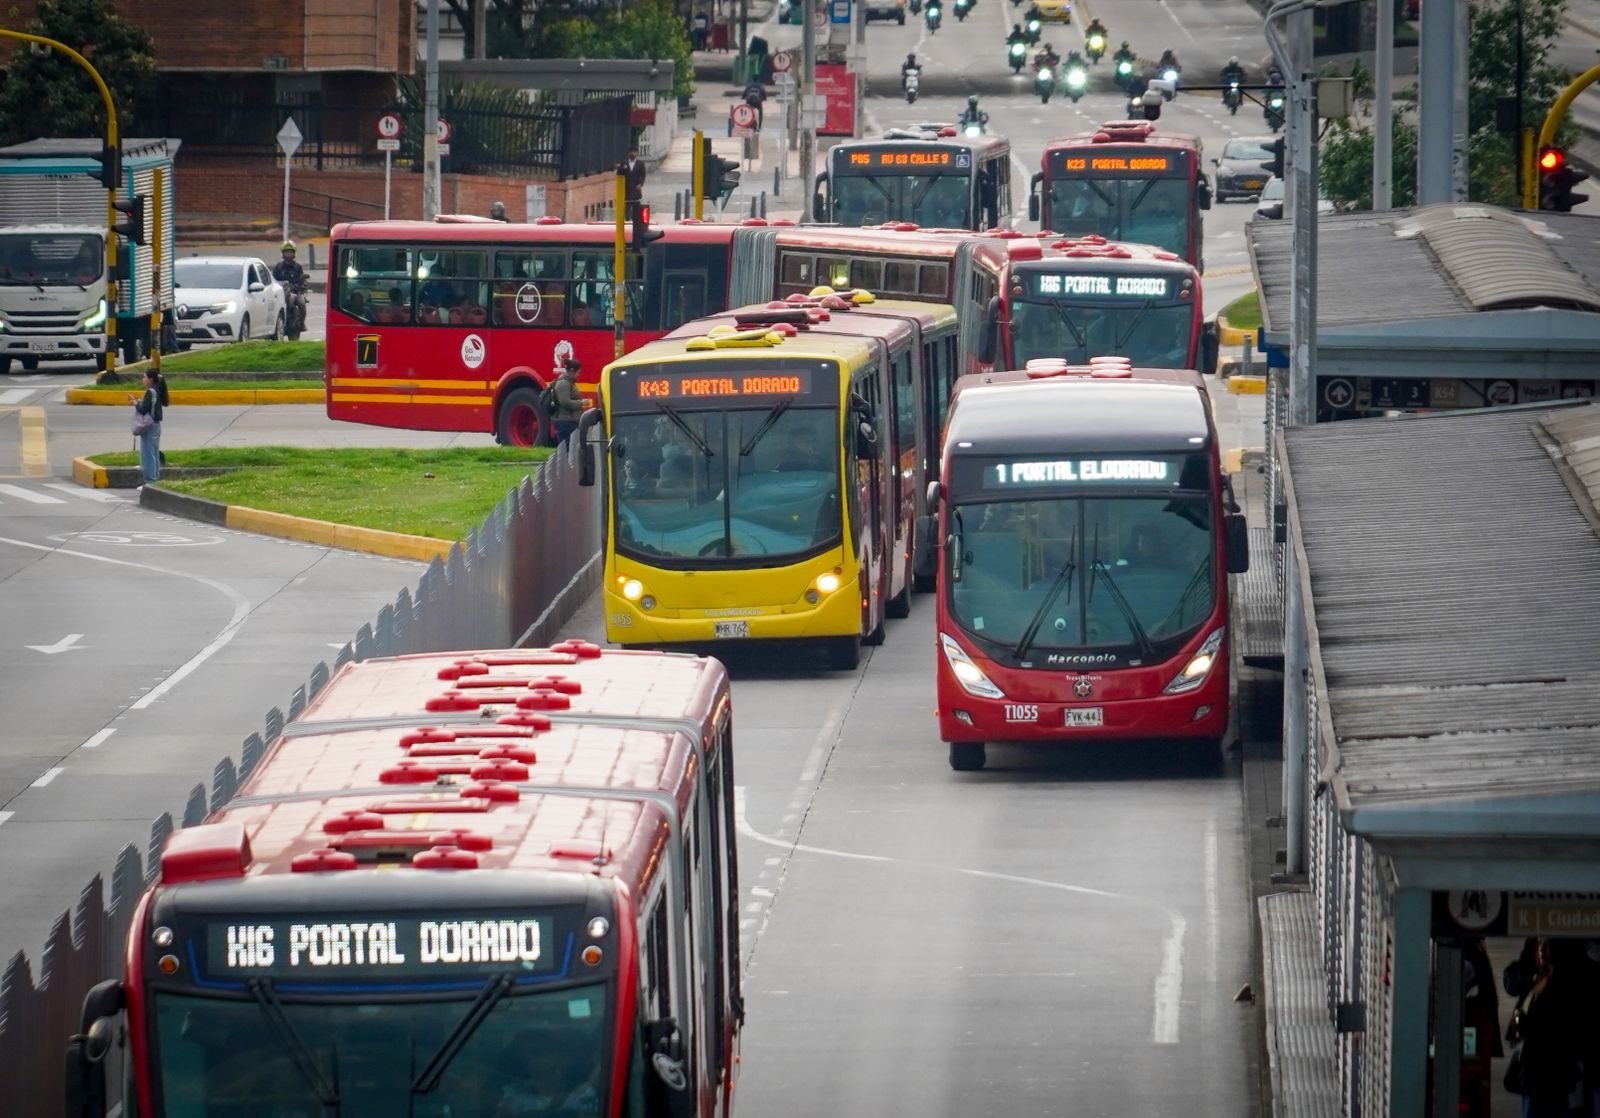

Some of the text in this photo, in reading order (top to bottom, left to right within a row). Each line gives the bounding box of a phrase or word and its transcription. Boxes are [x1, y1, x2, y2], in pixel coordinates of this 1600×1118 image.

[910, 153, 939, 164] CALLE
[1067, 158, 1166, 169] K23 PORTAL DORADO
[1065, 276, 1111, 293] PORTAL
[1116, 278, 1166, 294] DORADO
[640, 377, 799, 396] K43 PORTAL DORADO
[1012, 461, 1077, 482] PORTAL
[1047, 653, 1117, 664] Marcopolo
[1004, 704, 1039, 720] T1055
[1519, 907, 1528, 926] K
[227, 920, 540, 967] K16 PORTAL DORADO
